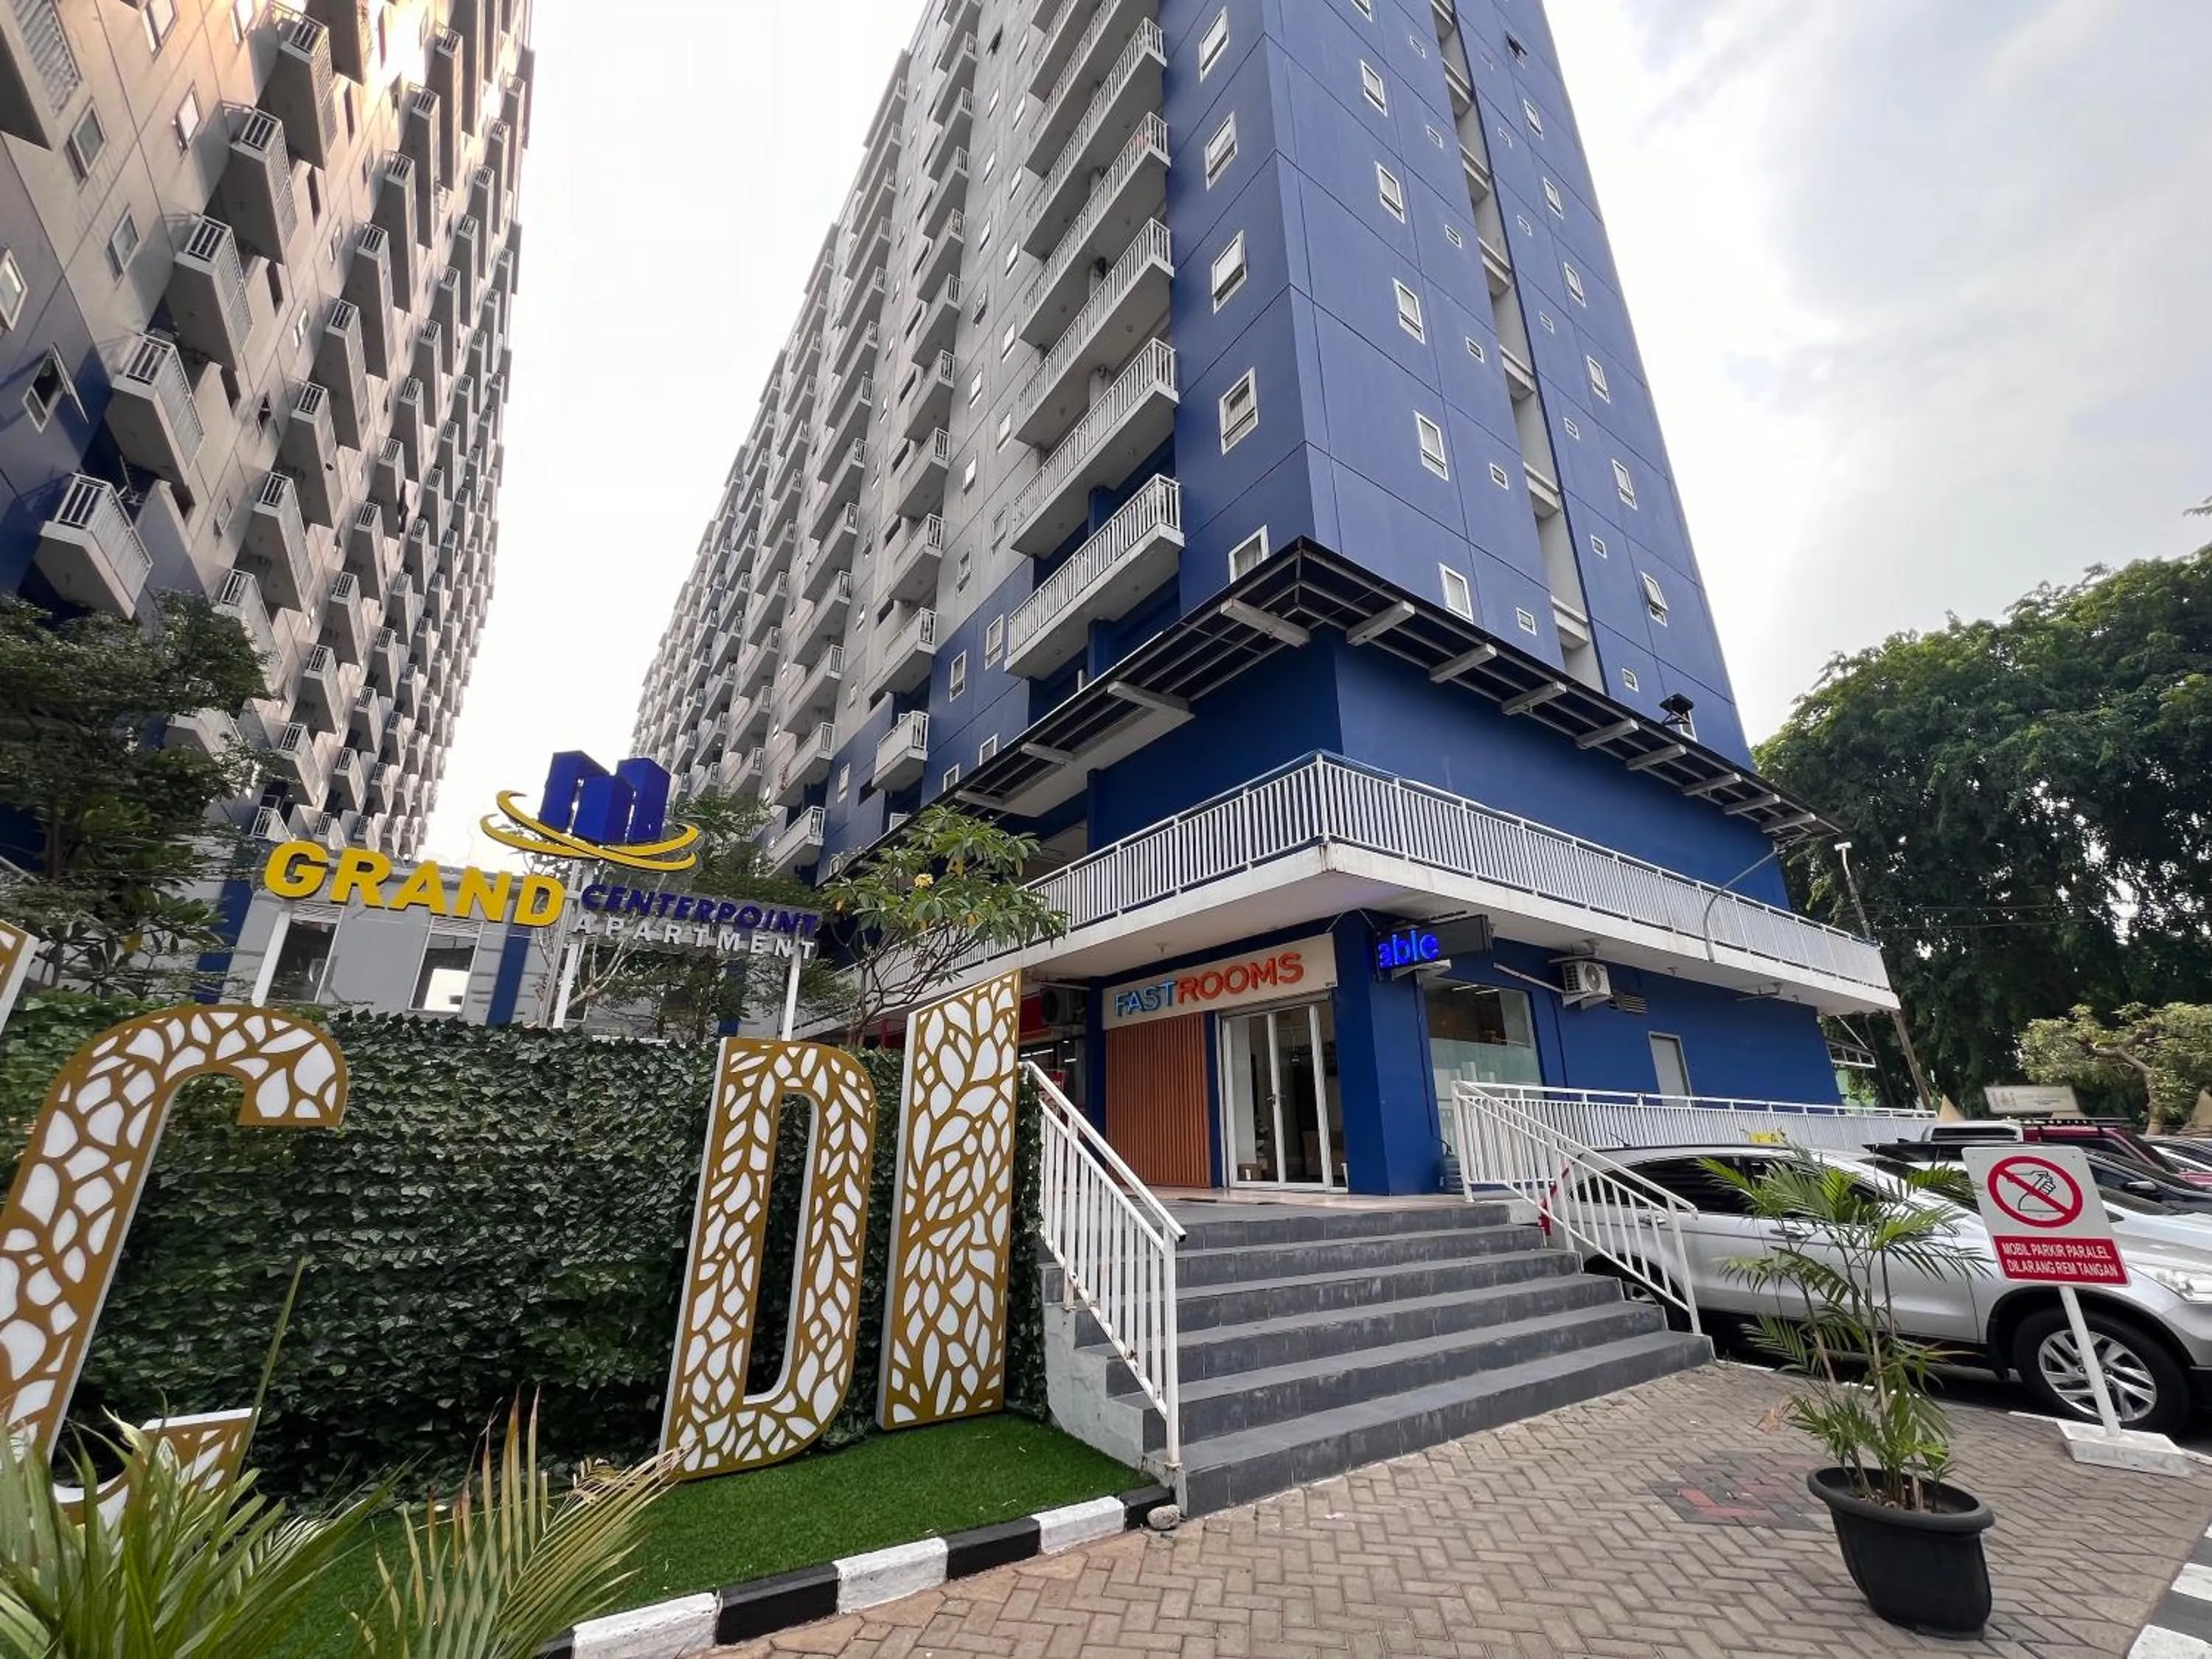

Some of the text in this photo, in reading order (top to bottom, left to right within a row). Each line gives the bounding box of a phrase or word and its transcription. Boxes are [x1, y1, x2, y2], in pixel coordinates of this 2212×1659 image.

[263, 840, 567, 928] GRAND
[580, 884, 819, 934] CENTERPOINT
[572, 910, 815, 959] APARTMENT
[1378, 930, 1439, 969] able
[2001, 1242, 2112, 1259] MOBIL PARKIR PARALEL
[2006, 1259, 2118, 1277] DILARANG REM TANGAN
